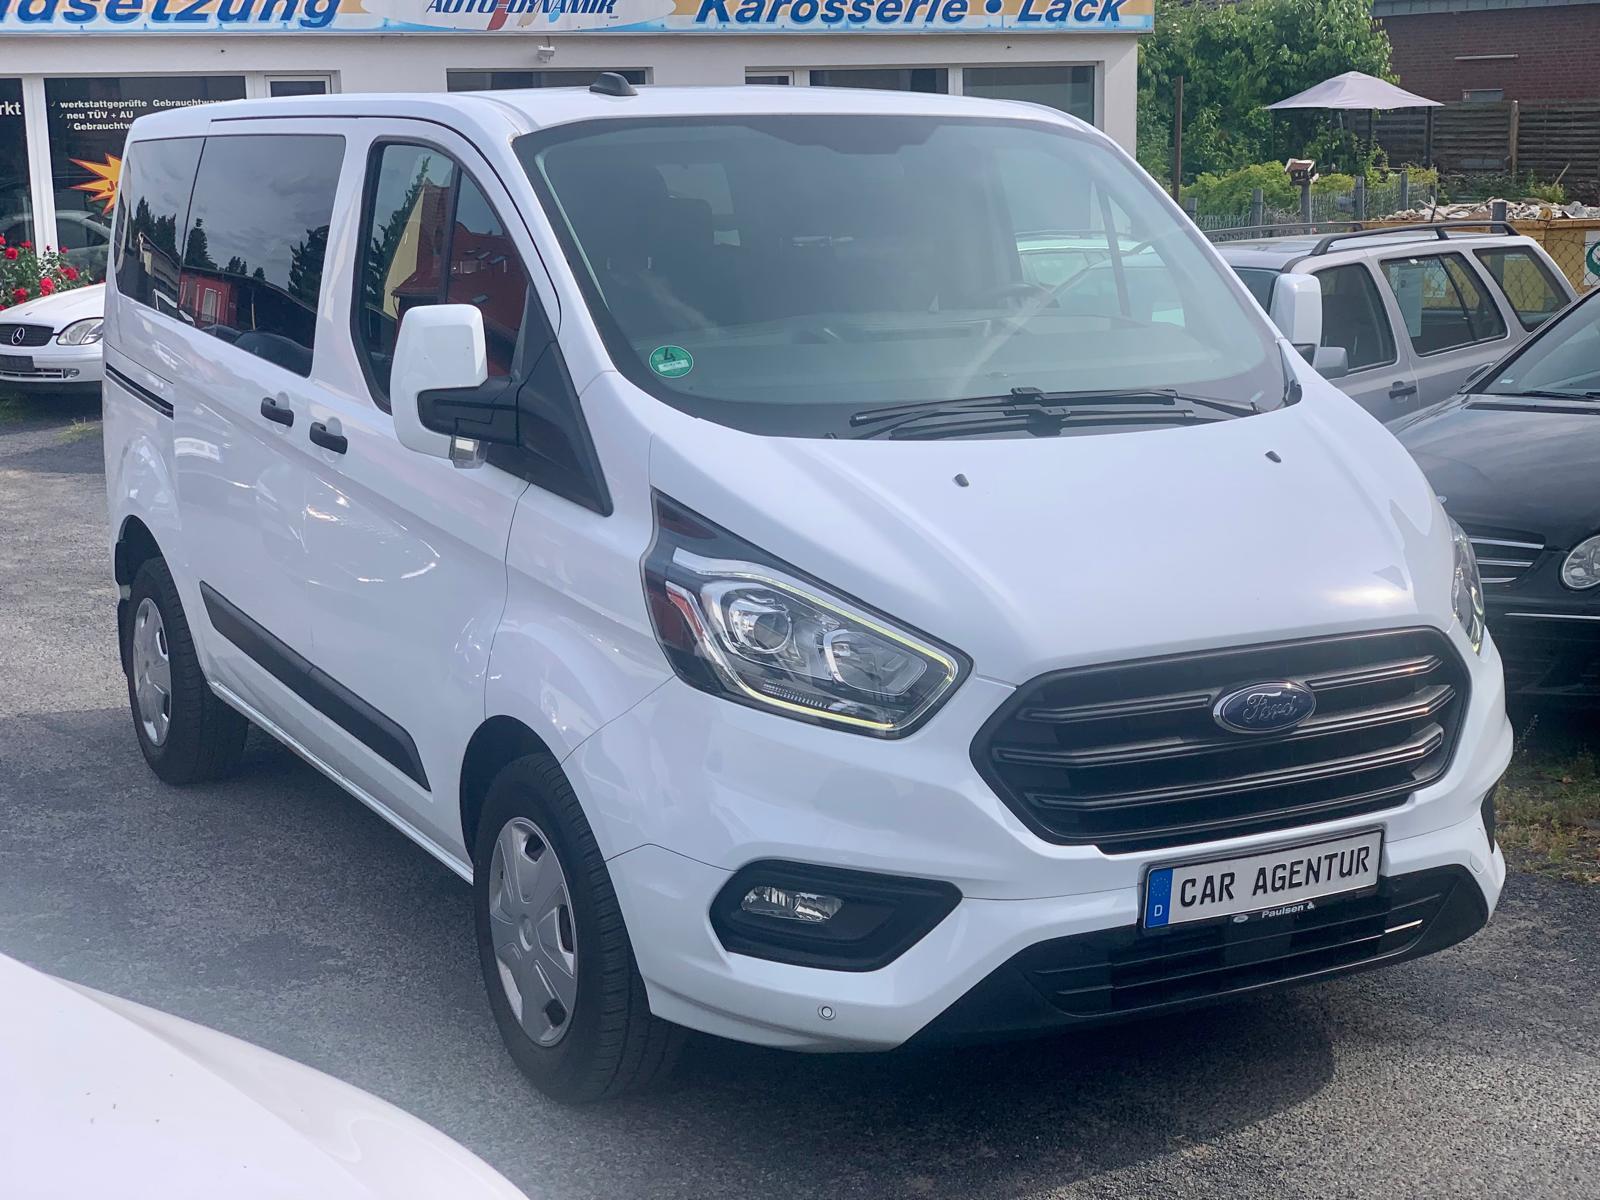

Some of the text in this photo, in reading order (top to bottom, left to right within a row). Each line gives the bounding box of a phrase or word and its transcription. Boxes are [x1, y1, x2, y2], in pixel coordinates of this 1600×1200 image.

[695, 0, 1127, 22] Karosserie Lack
[60, 100, 147, 109] werkstattgeprüfte
[87, 109, 108, 119] TÜV
[120, 110, 134, 119] AU
[1243, 691, 1298, 720] Ford
[1153, 846, 1370, 917] D CAR AGENTUR
[1261, 903, 1304, 919] Paulsen
